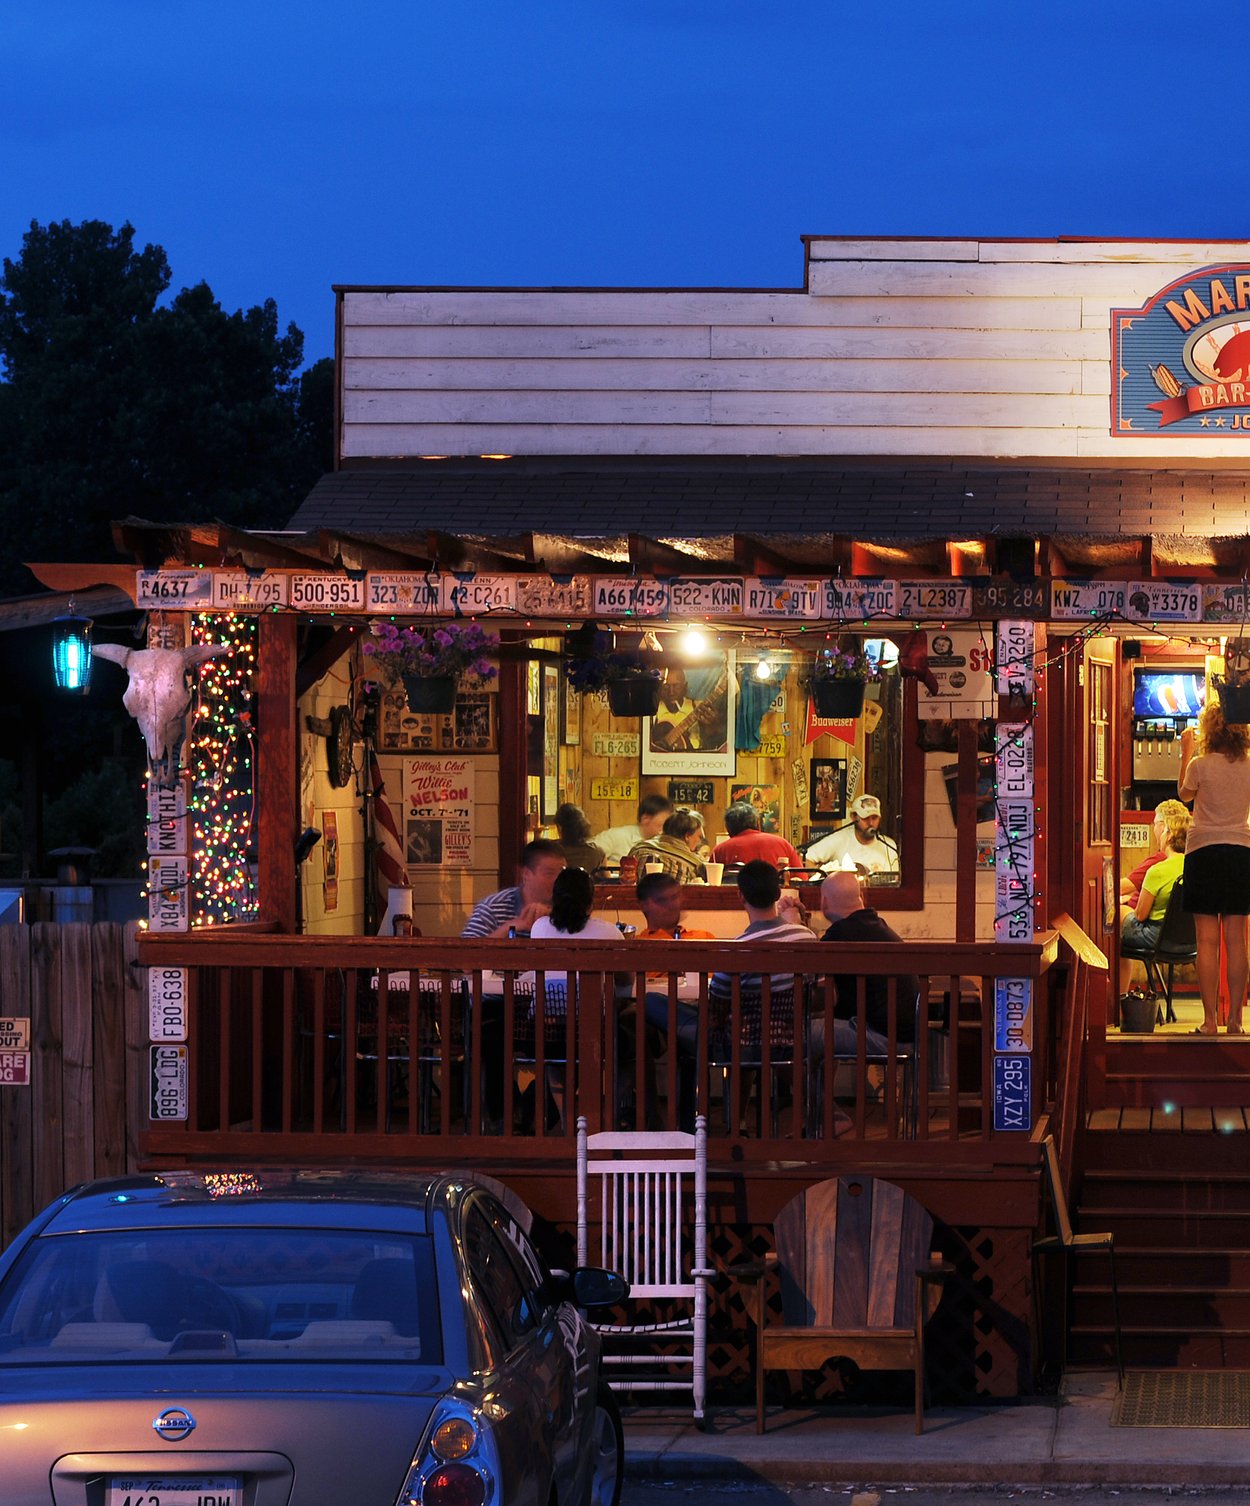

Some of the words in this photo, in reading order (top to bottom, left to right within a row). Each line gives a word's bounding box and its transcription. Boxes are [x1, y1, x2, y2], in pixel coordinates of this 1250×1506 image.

[307, 575, 348, 583] KENTUCKY
[151, 580, 189, 598] 4637
[372, 585, 398, 604] 323
[1053, 590, 1080, 608] KWZ
[1161, 593, 1198, 611] 3378
[688, 605, 726, 613] COLORADO
[411, 776, 453, 790] Willie
[410, 787, 468, 808] NELSON
[410, 808, 436, 817] OCT.
[1009, 804, 1027, 832] NDJ
[445, 834, 472, 846] GILLEY'S
[1004, 1059, 1023, 1091] 295
[1004, 1096, 1023, 1126] XZY
[120, 1480, 134, 1492] SEP
[145, 1480, 202, 1493] Tennessee
